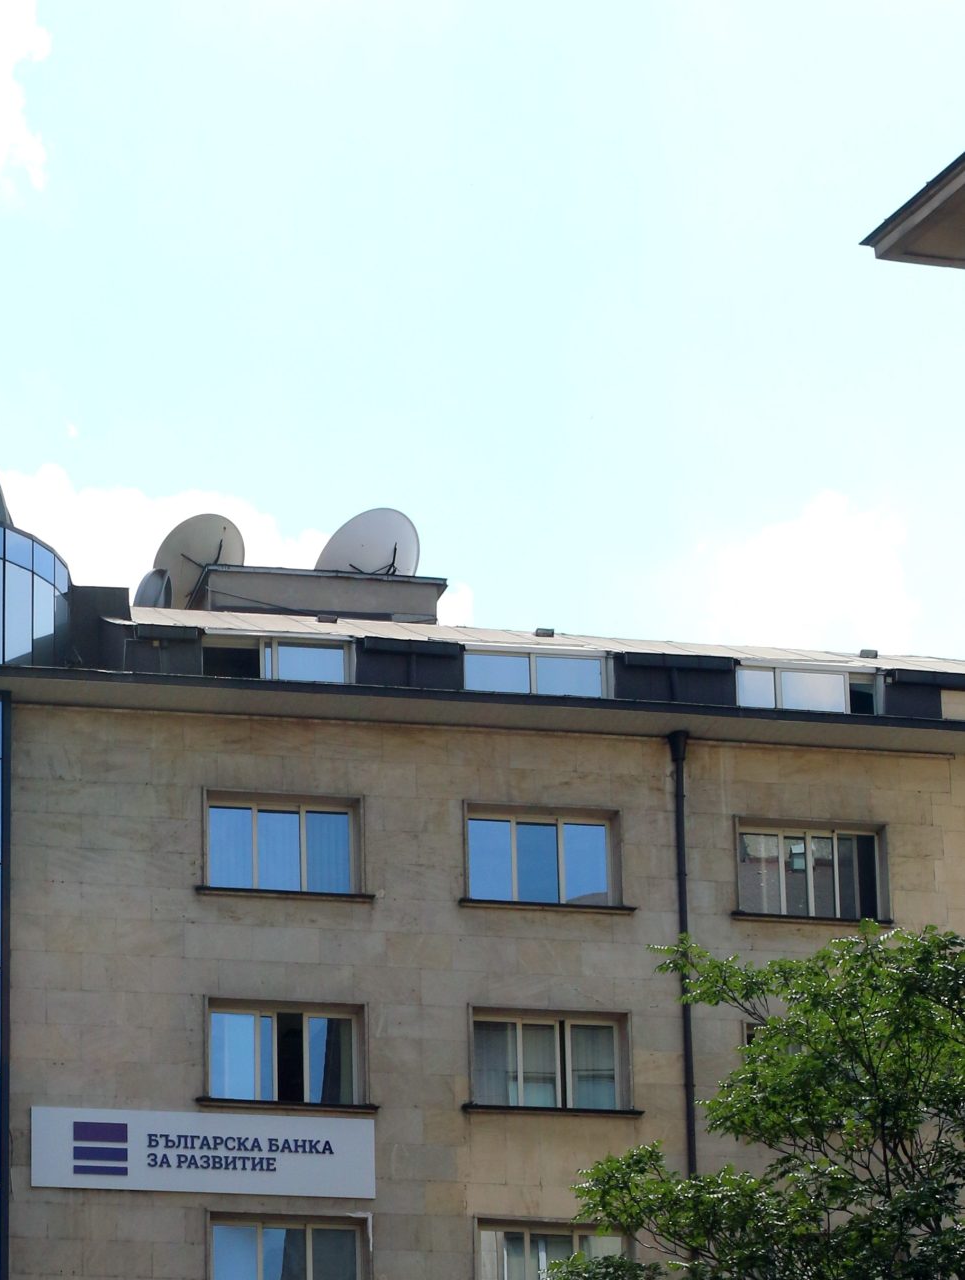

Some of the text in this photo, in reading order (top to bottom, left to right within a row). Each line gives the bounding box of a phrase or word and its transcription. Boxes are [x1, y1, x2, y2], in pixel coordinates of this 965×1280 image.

[148, 1133, 333, 1154] БЪЛГАРСКА БАНКА
[148, 1153, 276, 1171] ЗА РАЗВИТИЕ
